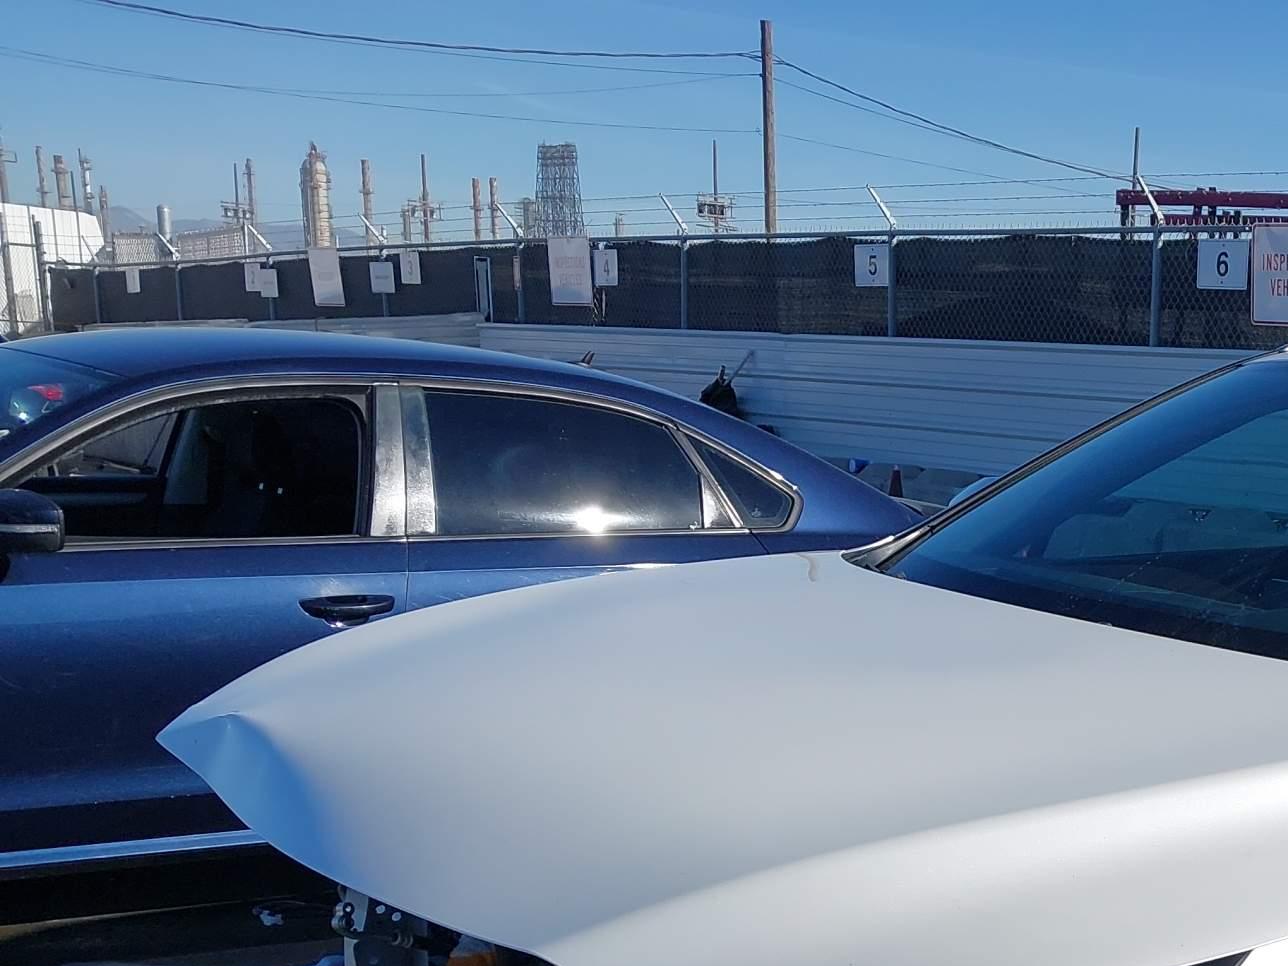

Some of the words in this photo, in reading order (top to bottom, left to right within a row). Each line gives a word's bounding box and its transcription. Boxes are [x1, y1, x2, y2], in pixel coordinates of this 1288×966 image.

[603, 259, 610, 277] 4
[867, 254, 878, 276] 5
[1216, 251, 1229, 278] 6
[1049, 351, 1059, 365] 3
